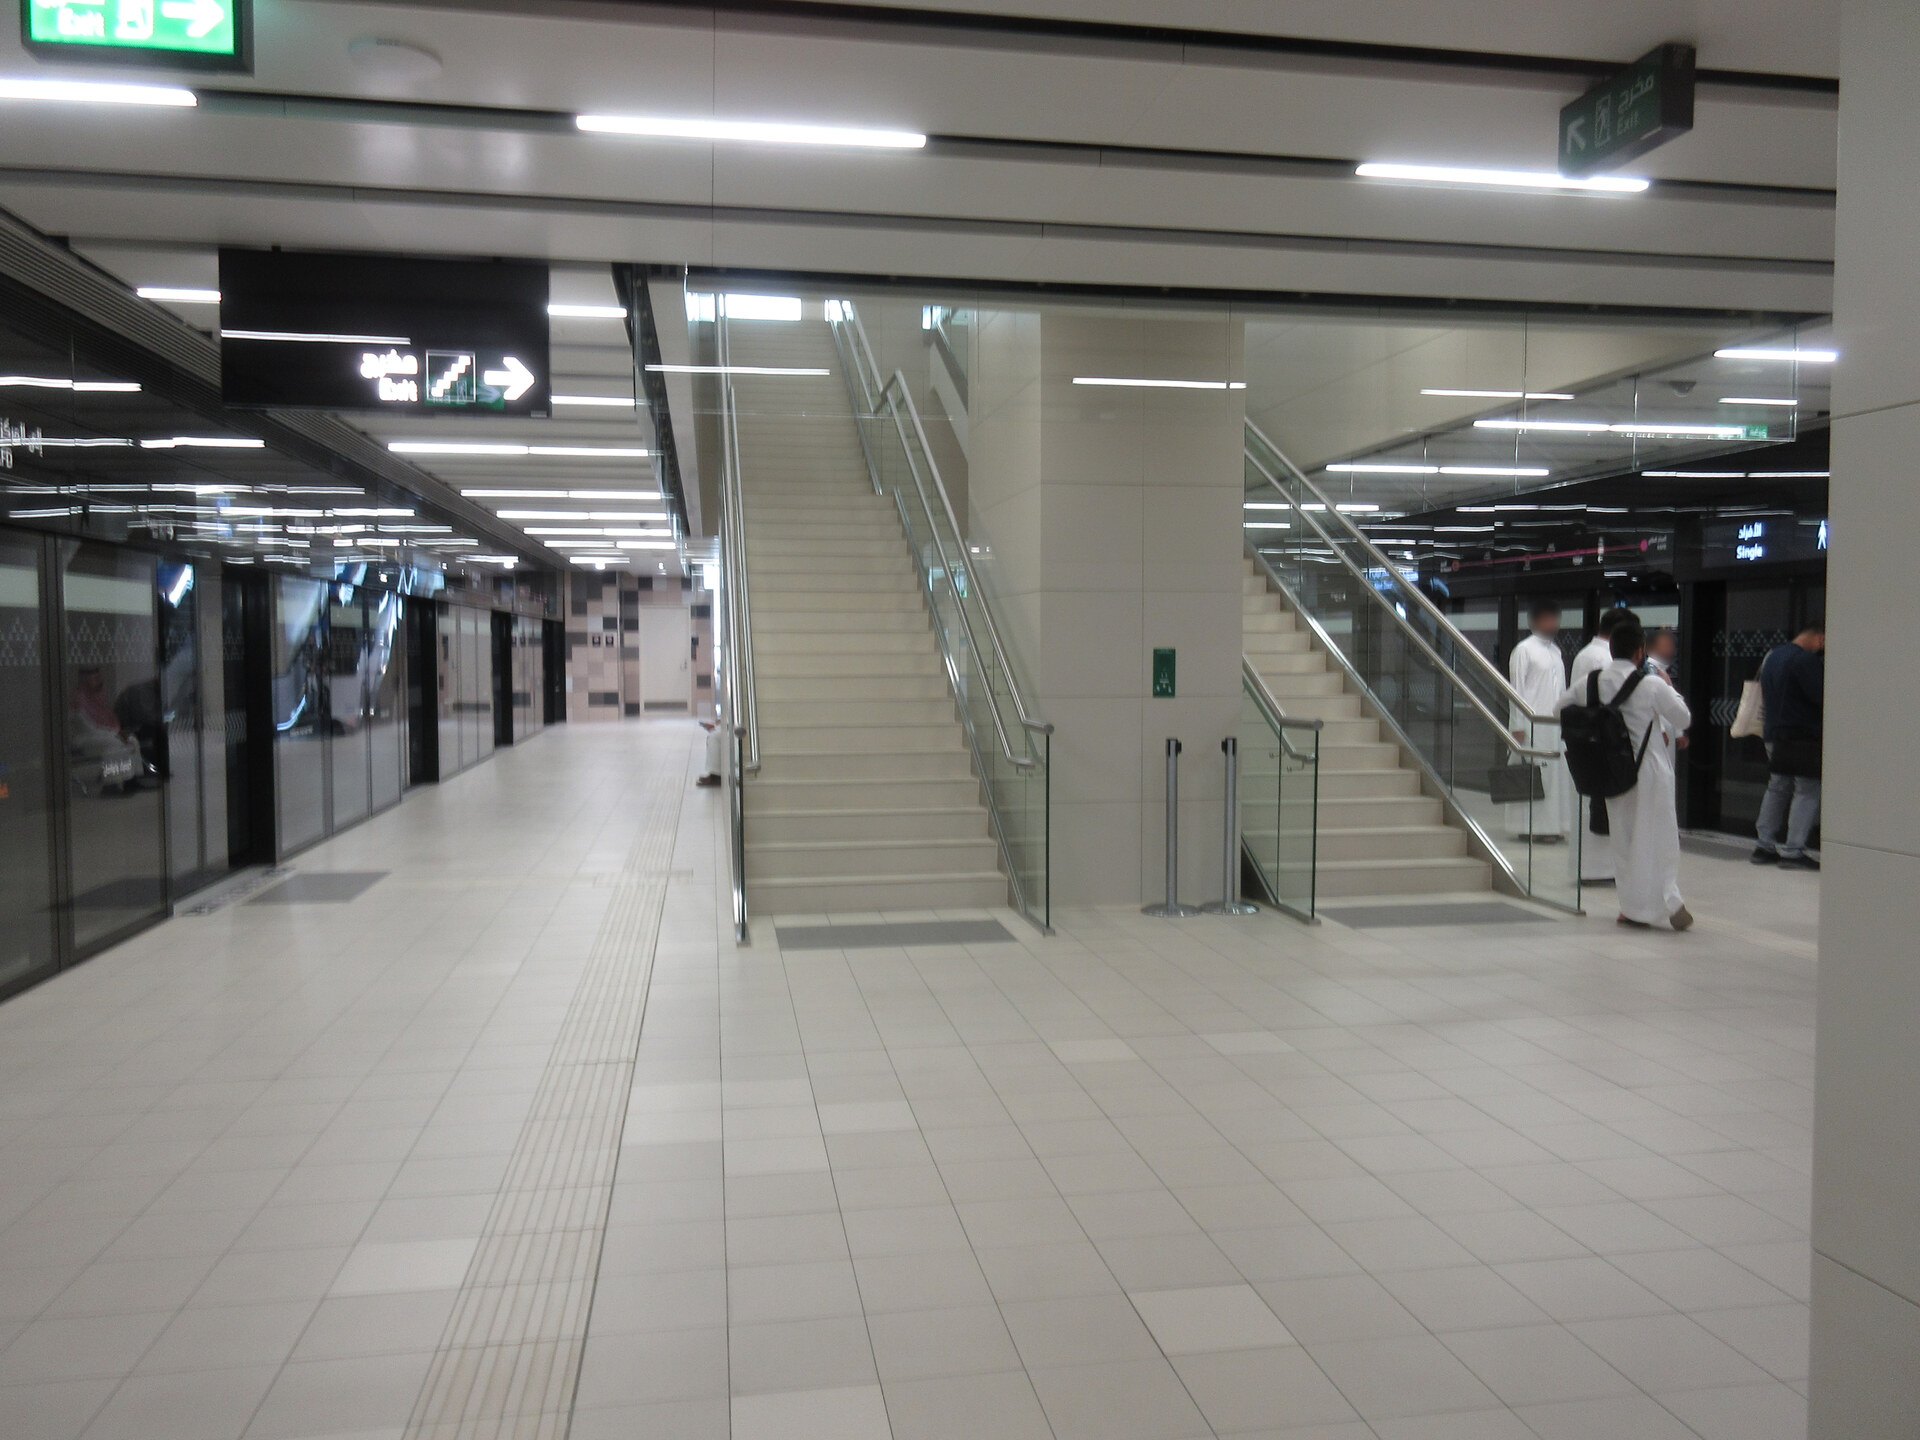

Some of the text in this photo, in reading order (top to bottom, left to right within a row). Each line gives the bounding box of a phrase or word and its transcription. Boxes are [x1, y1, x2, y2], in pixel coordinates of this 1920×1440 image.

[1618, 74, 1654, 114] مخرج
[1616, 111, 1640, 136] Exit
[379, 378, 418, 402] Exit
[1736, 543, 1763, 561] Single
